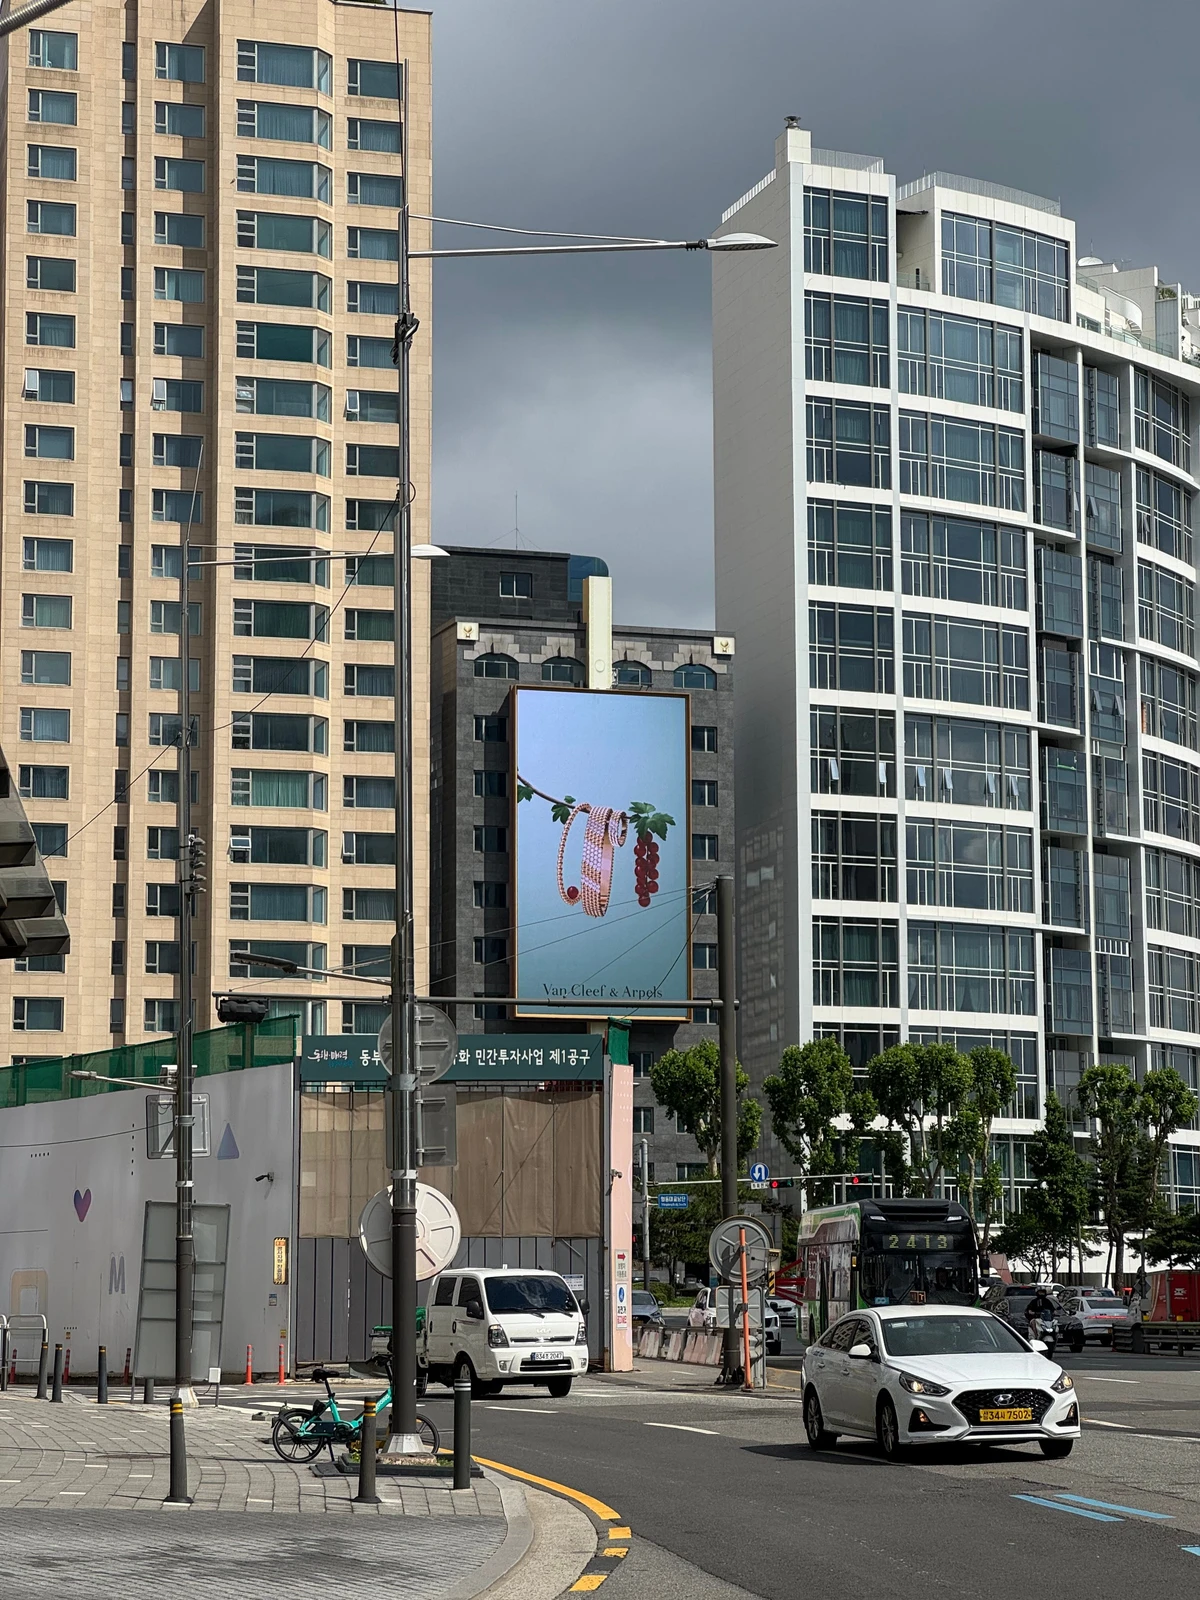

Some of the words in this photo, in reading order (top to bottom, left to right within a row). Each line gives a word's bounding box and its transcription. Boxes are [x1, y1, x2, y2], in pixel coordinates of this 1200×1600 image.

[543, 983, 567, 996] Van
[571, 983, 607, 997] Cleef
[609, 987, 619, 998] &
[621, 985, 663, 1000] Arpels
[475, 1048, 544, 1066] 민간투자사업
[549, 1048, 591, 1066] 제1공구
[1007, 1409, 1029, 1420] 7502
